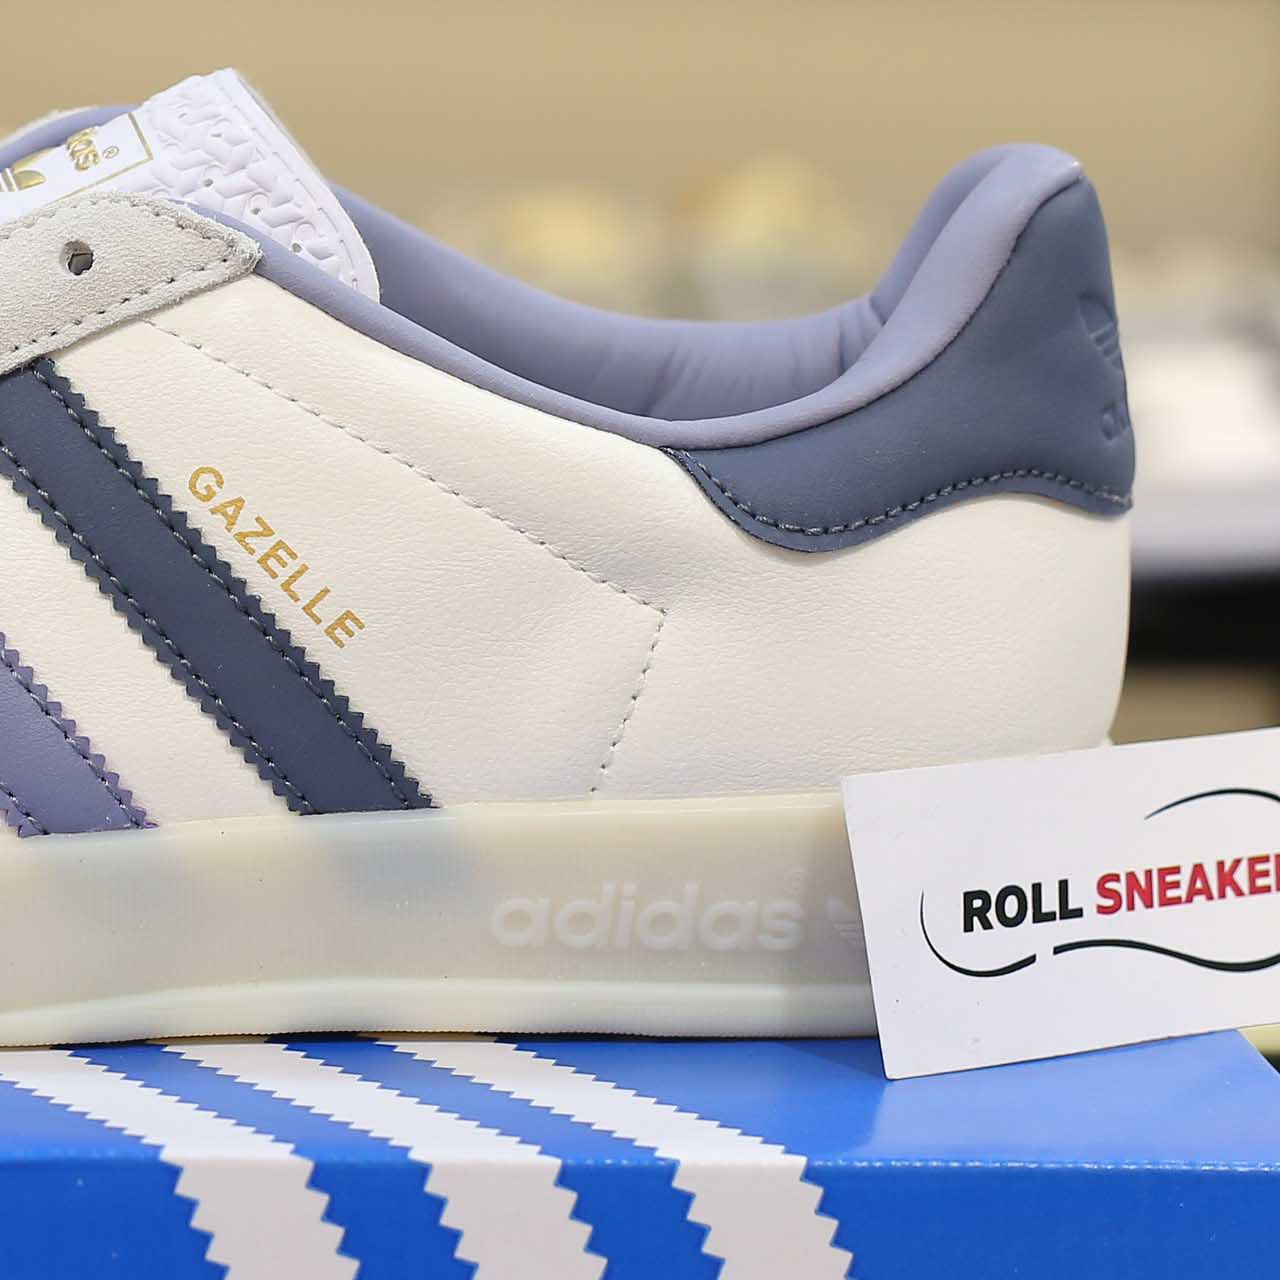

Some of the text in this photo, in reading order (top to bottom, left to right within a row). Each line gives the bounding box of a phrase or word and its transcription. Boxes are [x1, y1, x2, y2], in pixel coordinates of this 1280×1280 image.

[188, 466, 366, 649] GAZELLE
[491, 880, 805, 951] adidas
[962, 879, 1083, 933] ROLL
